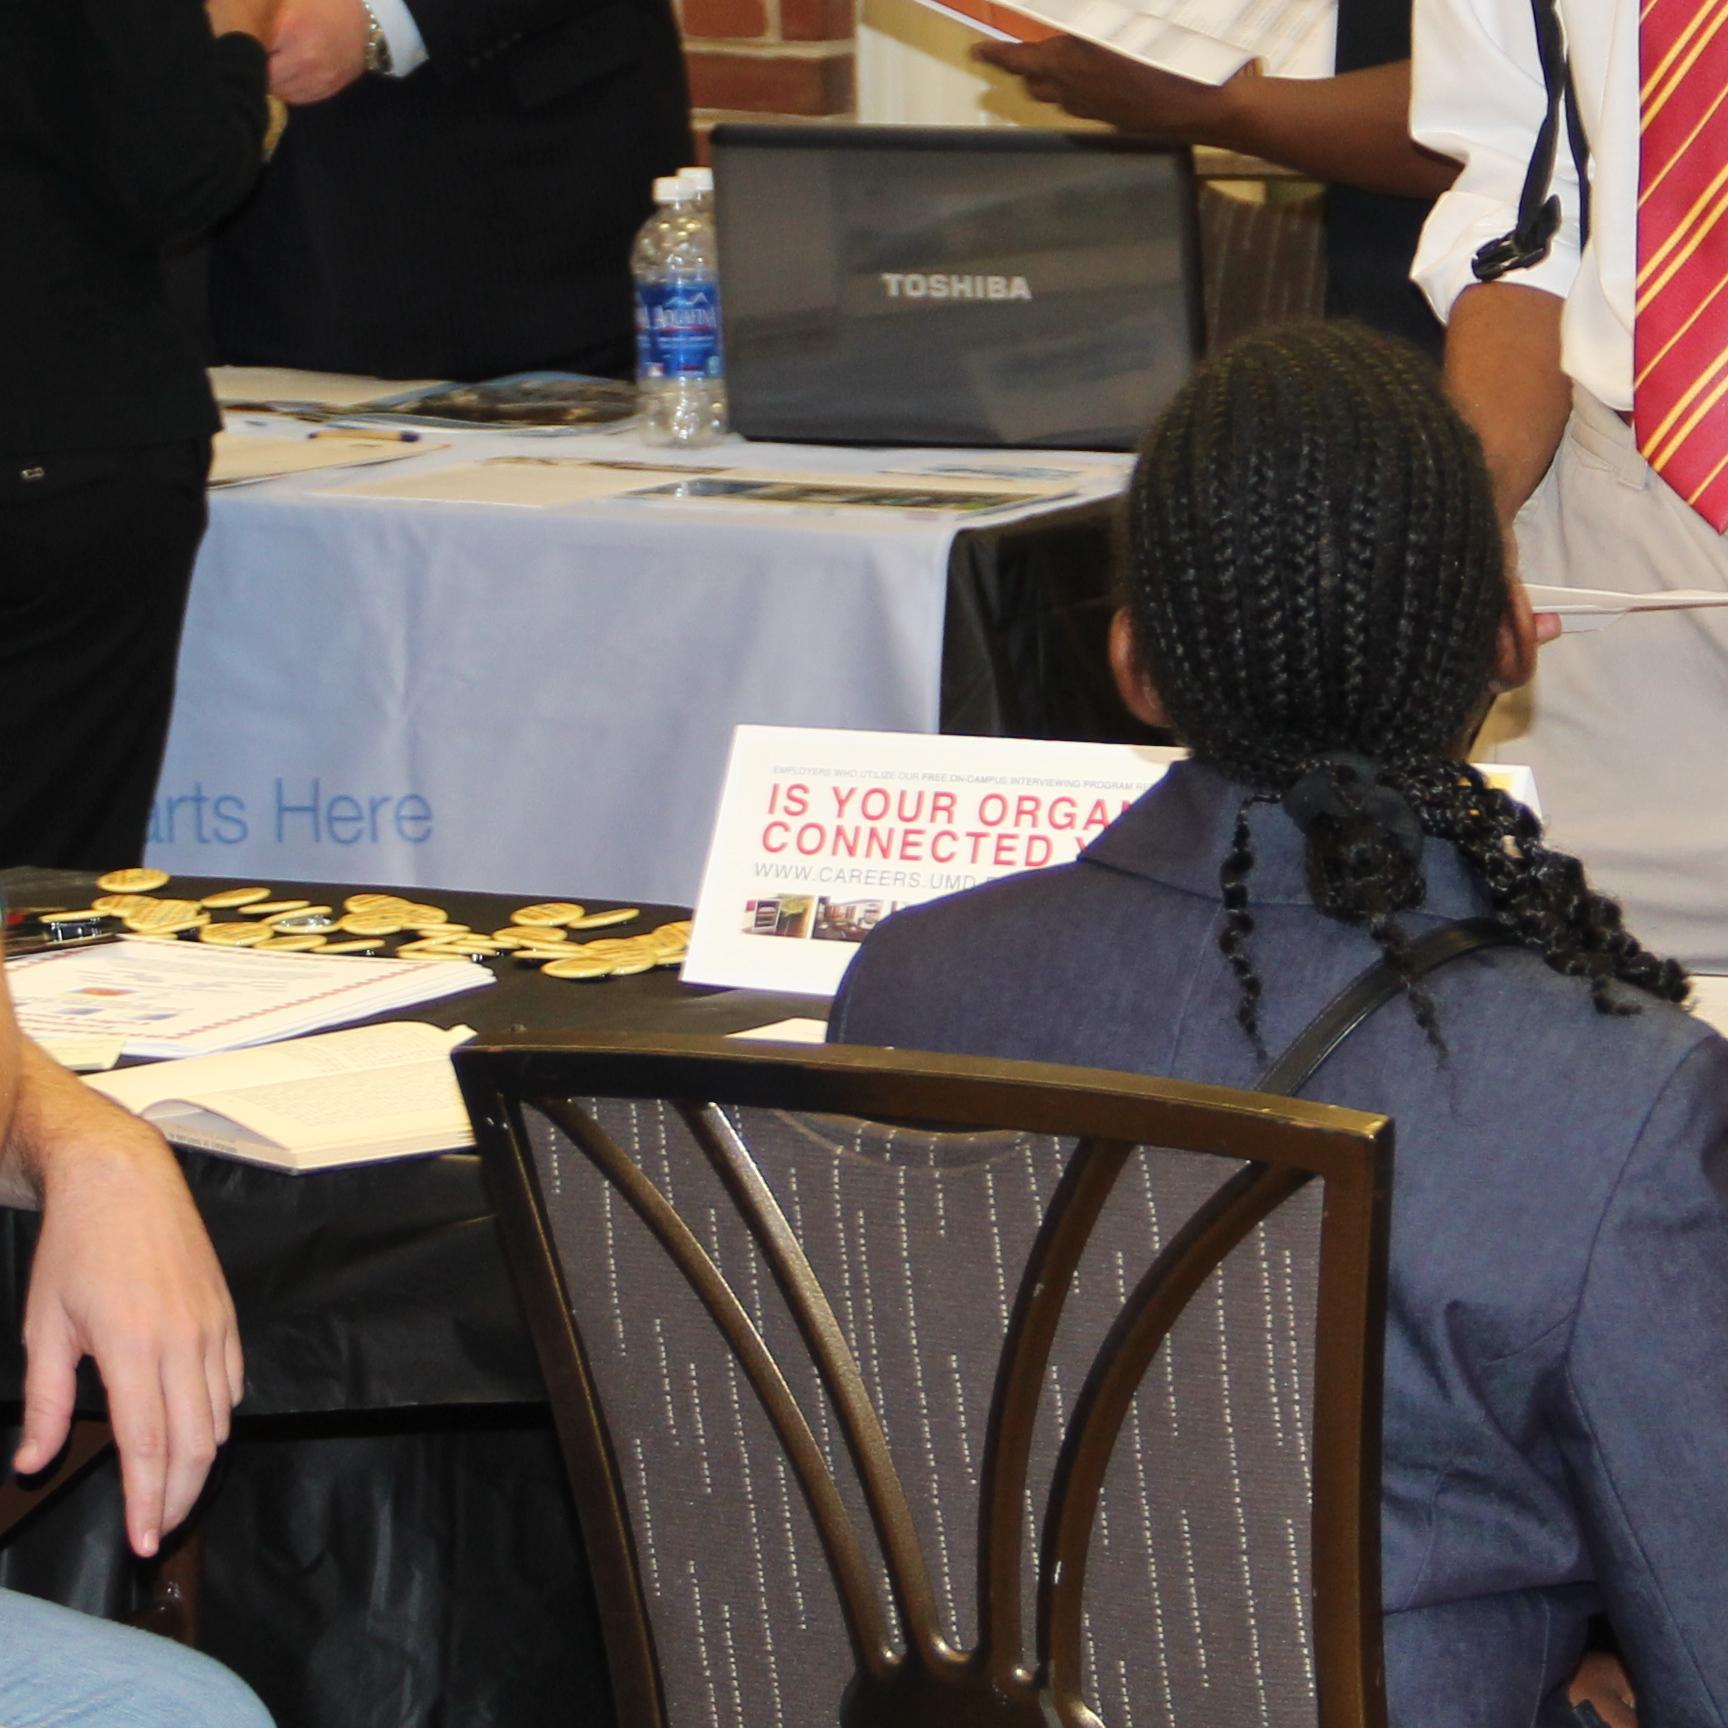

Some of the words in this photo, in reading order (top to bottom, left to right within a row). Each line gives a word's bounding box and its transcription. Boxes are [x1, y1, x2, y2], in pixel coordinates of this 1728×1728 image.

[880, 272, 1033, 300] TOSHIBA
[772, 765, 832, 777] EMPLOYERS
[834, 768, 858, 778] WHO
[897, 771, 920, 781] OUR
[922, 772, 948, 783] FREE
[1010, 776, 1081, 789] INTERVIEWING
[1083, 779, 1133, 791] PROGRAM
[273, 776, 434, 846] Here
[767, 782, 812, 818] IS
[832, 785, 959, 825] YOUR
[976, 792, 1134, 832] ORGA
[760, 820, 1055, 869] CONNECTED
